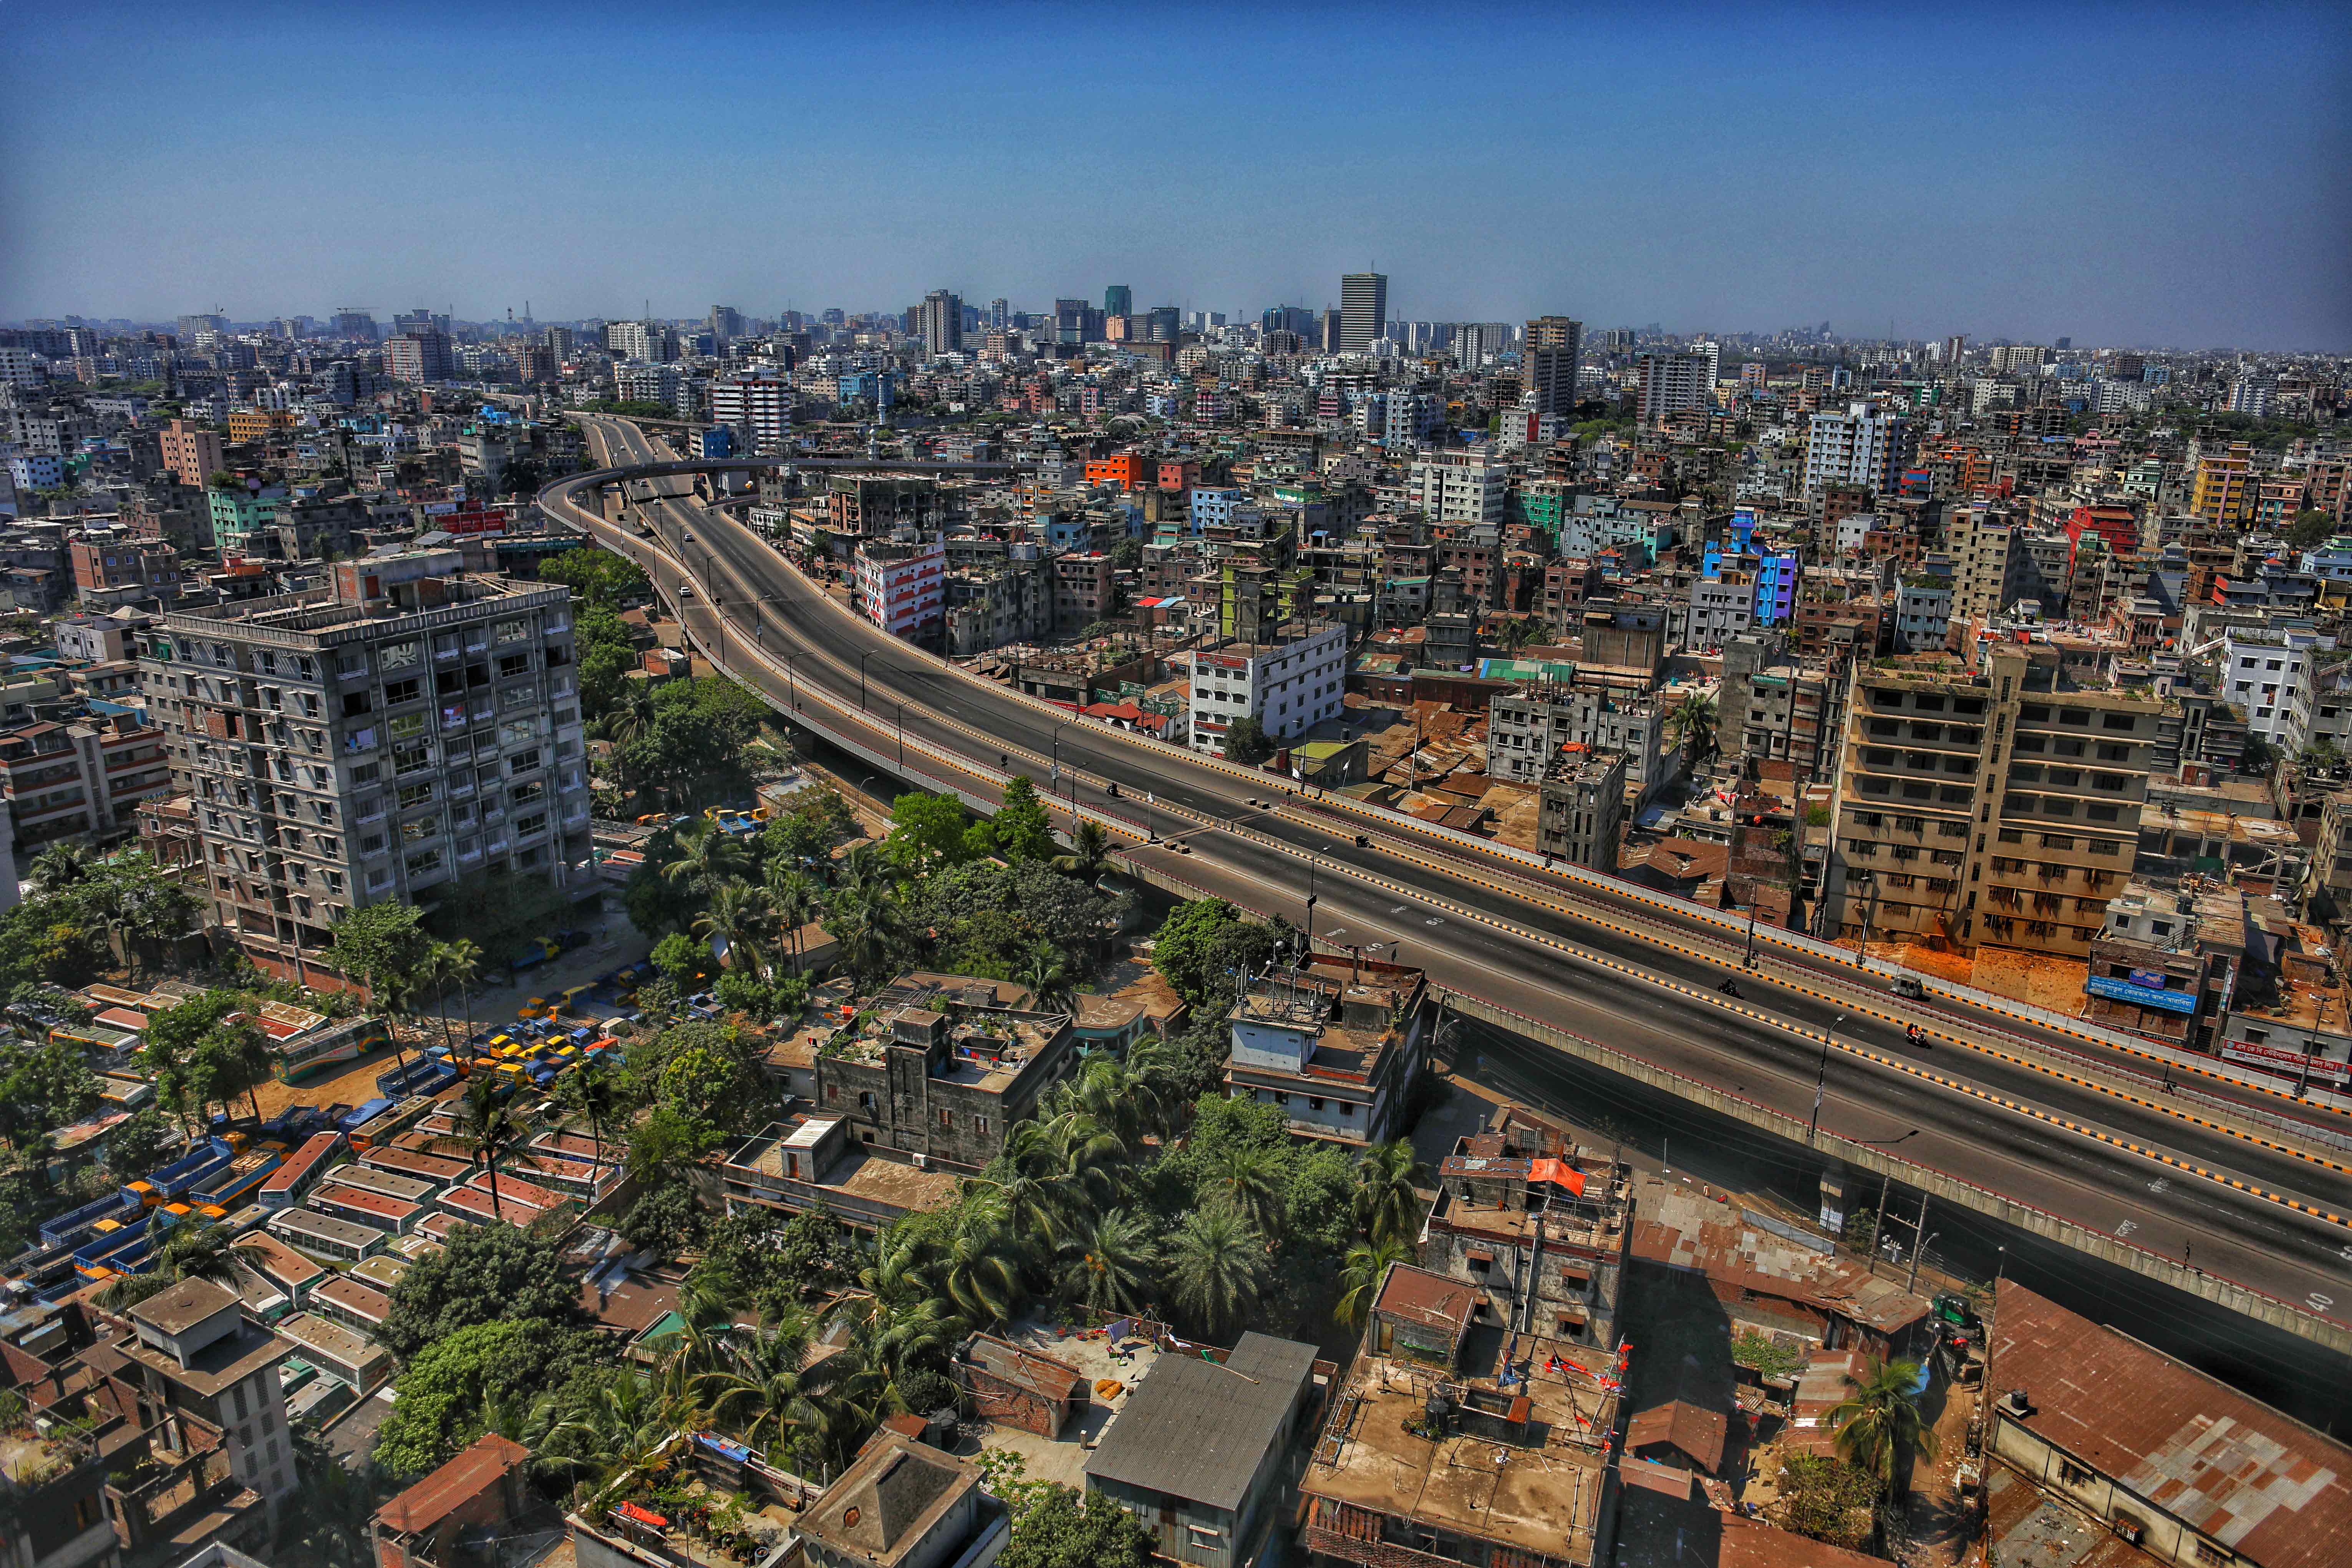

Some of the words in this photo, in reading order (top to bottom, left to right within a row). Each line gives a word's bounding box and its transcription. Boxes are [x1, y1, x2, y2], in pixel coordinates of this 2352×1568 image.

[1426, 917, 1445, 925] 60
[2257, 1046, 2263, 1054] বি
[2306, 1293, 2334, 1312] 40
